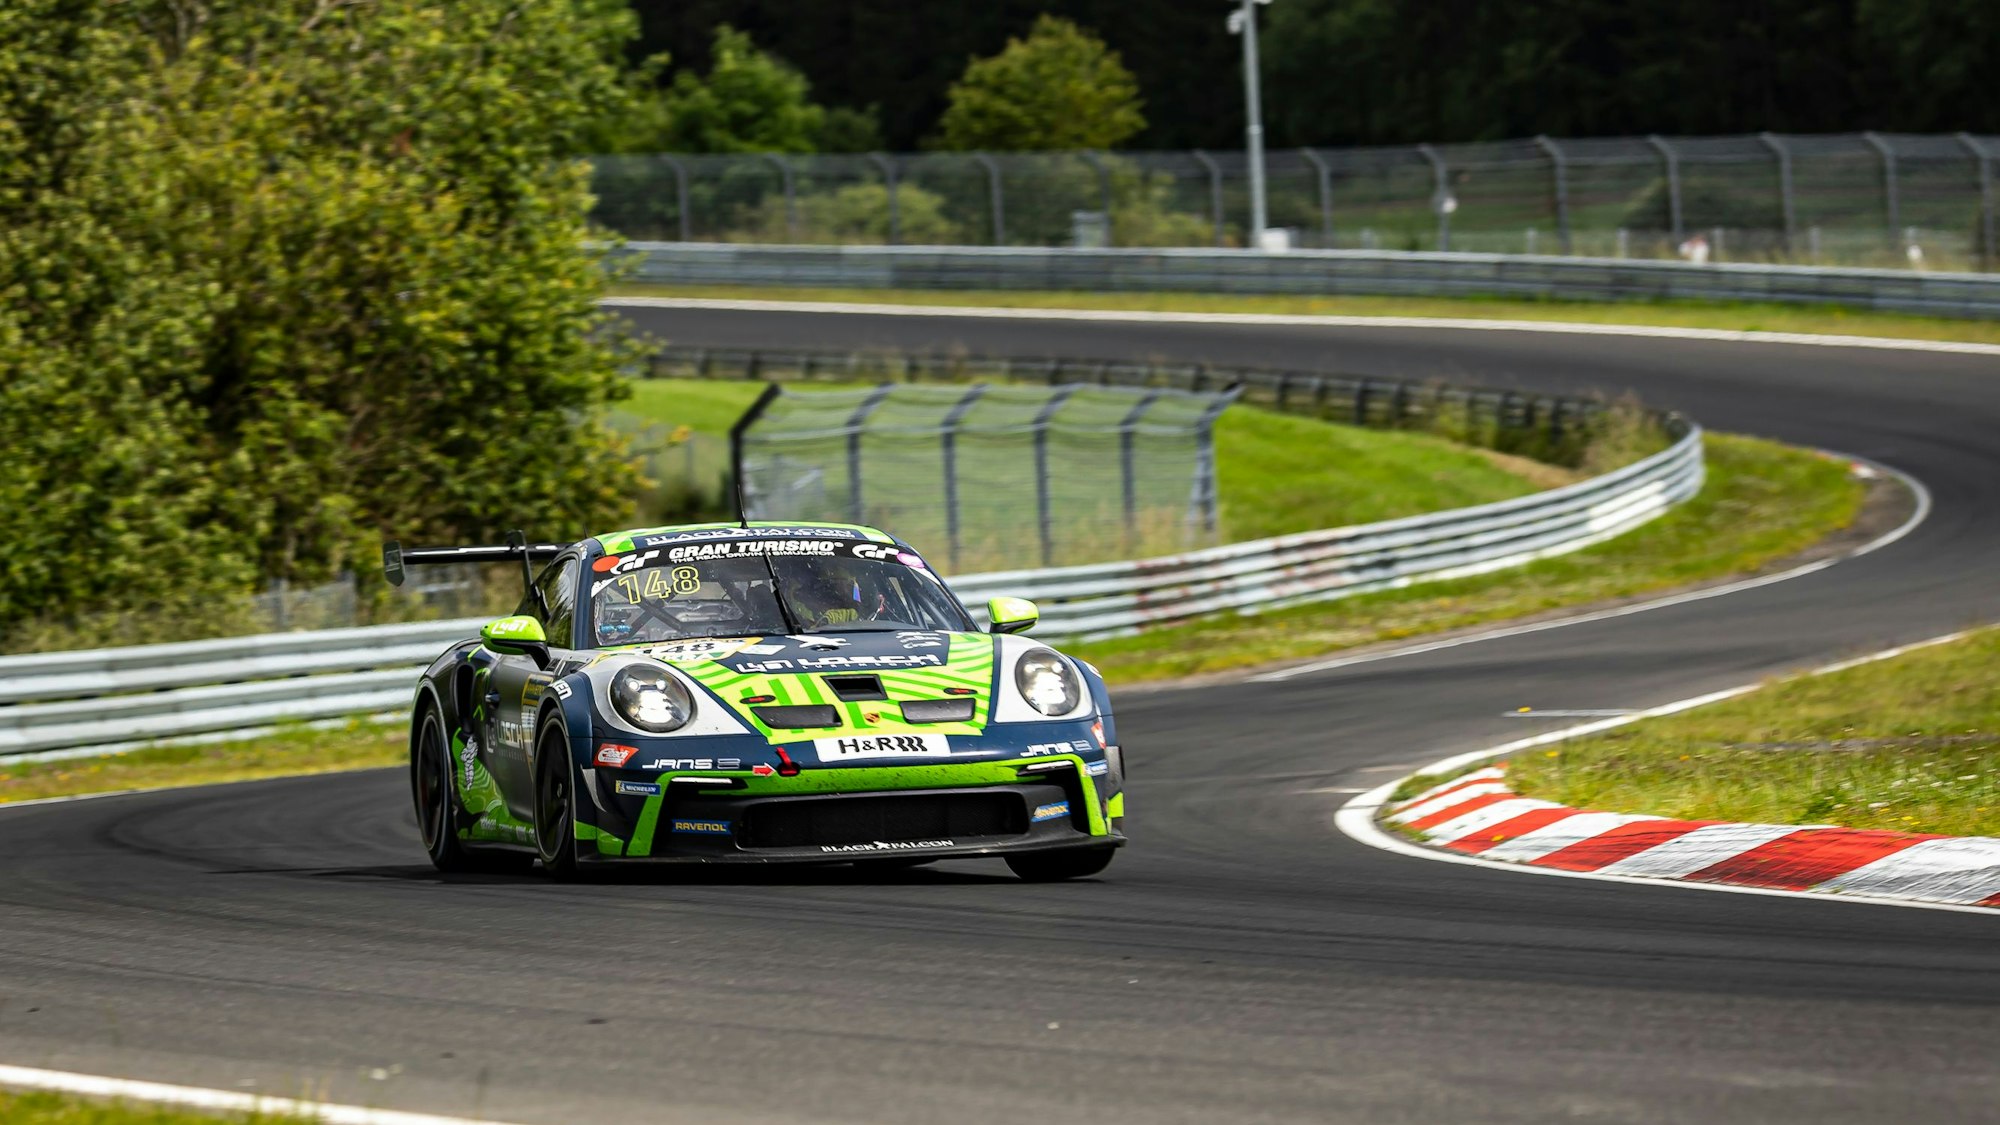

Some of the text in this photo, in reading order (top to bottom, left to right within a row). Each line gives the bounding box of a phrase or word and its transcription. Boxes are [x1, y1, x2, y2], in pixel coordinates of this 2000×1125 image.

[669, 542, 731, 559] GRAN
[671, 556, 695, 564] THE
[696, 554, 725, 562] REAL
[618, 565, 701, 605] 148
[838, 736, 896, 754] H&R
[642, 758, 713, 770] JANS
[675, 822, 726, 832] RAVENOL
[820, 839, 954, 853] BLACK FALCON
